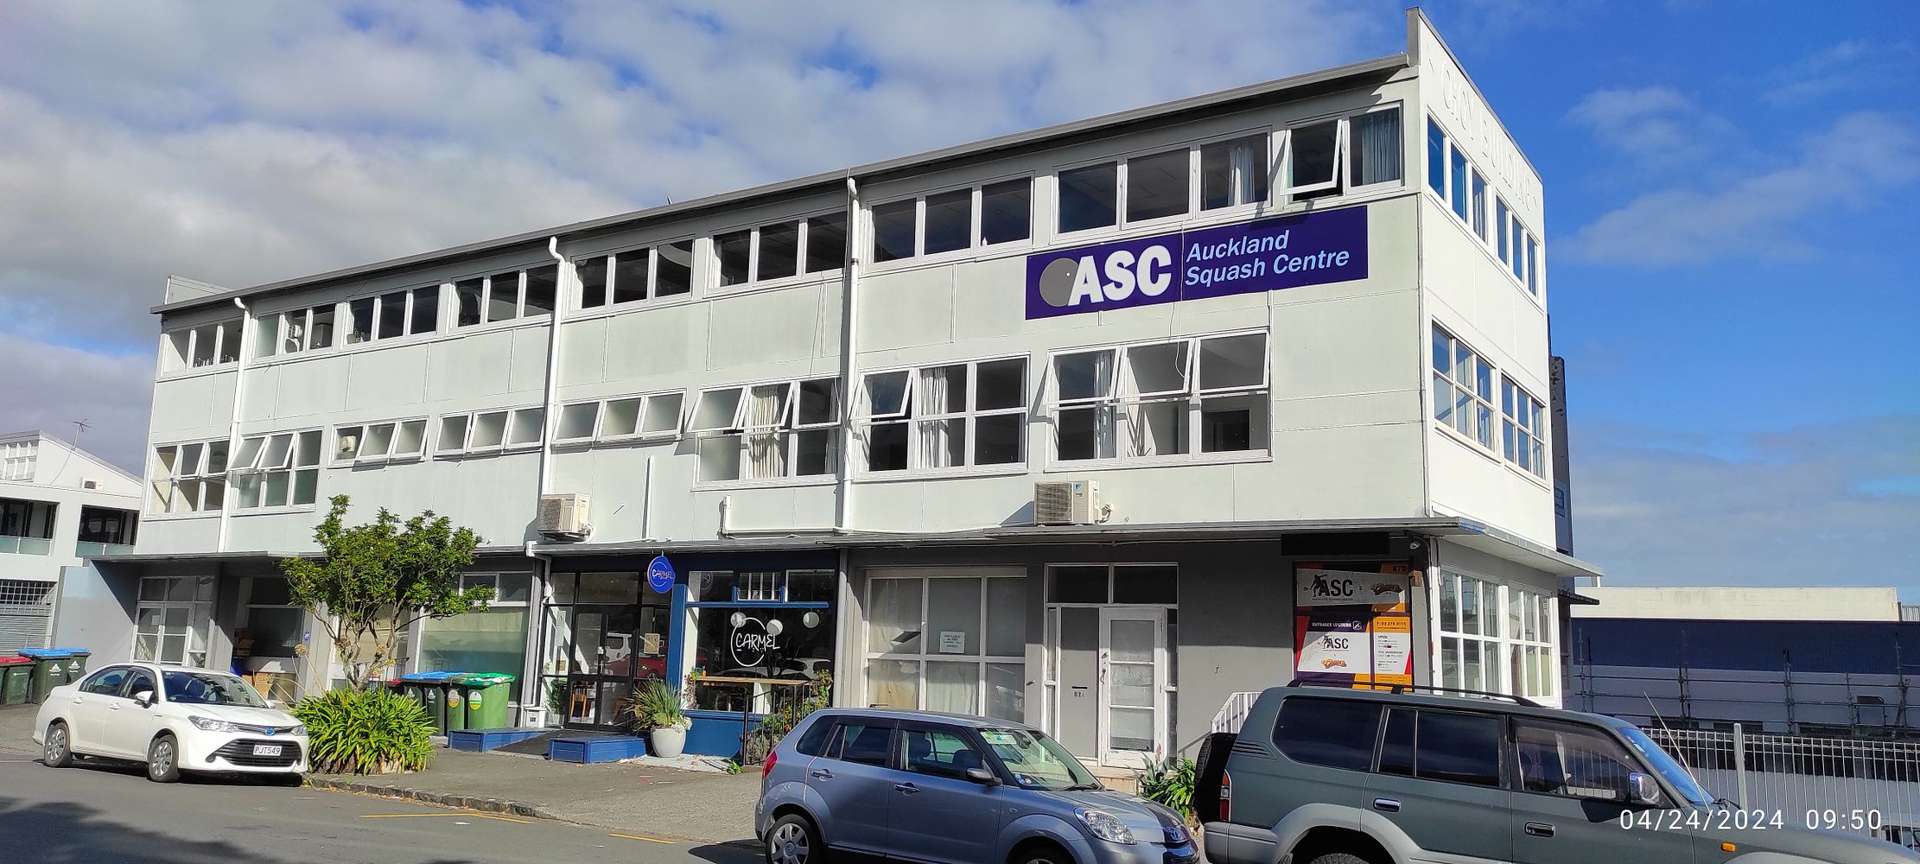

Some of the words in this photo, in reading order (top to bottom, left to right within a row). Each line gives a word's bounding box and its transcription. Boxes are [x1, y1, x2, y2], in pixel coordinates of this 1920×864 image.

[1186, 229, 1290, 263] Auckland
[1068, 244, 1172, 307] ASC
[1185, 257, 1265, 287] Squash
[1273, 249, 1350, 275] Centre
[652, 568, 675, 580] CARMEL
[1318, 578, 1353, 596] ASC
[735, 632, 781, 652] CARMEL
[1326, 637, 1349, 650] ASC
[254, 746, 281, 755] PJT549
